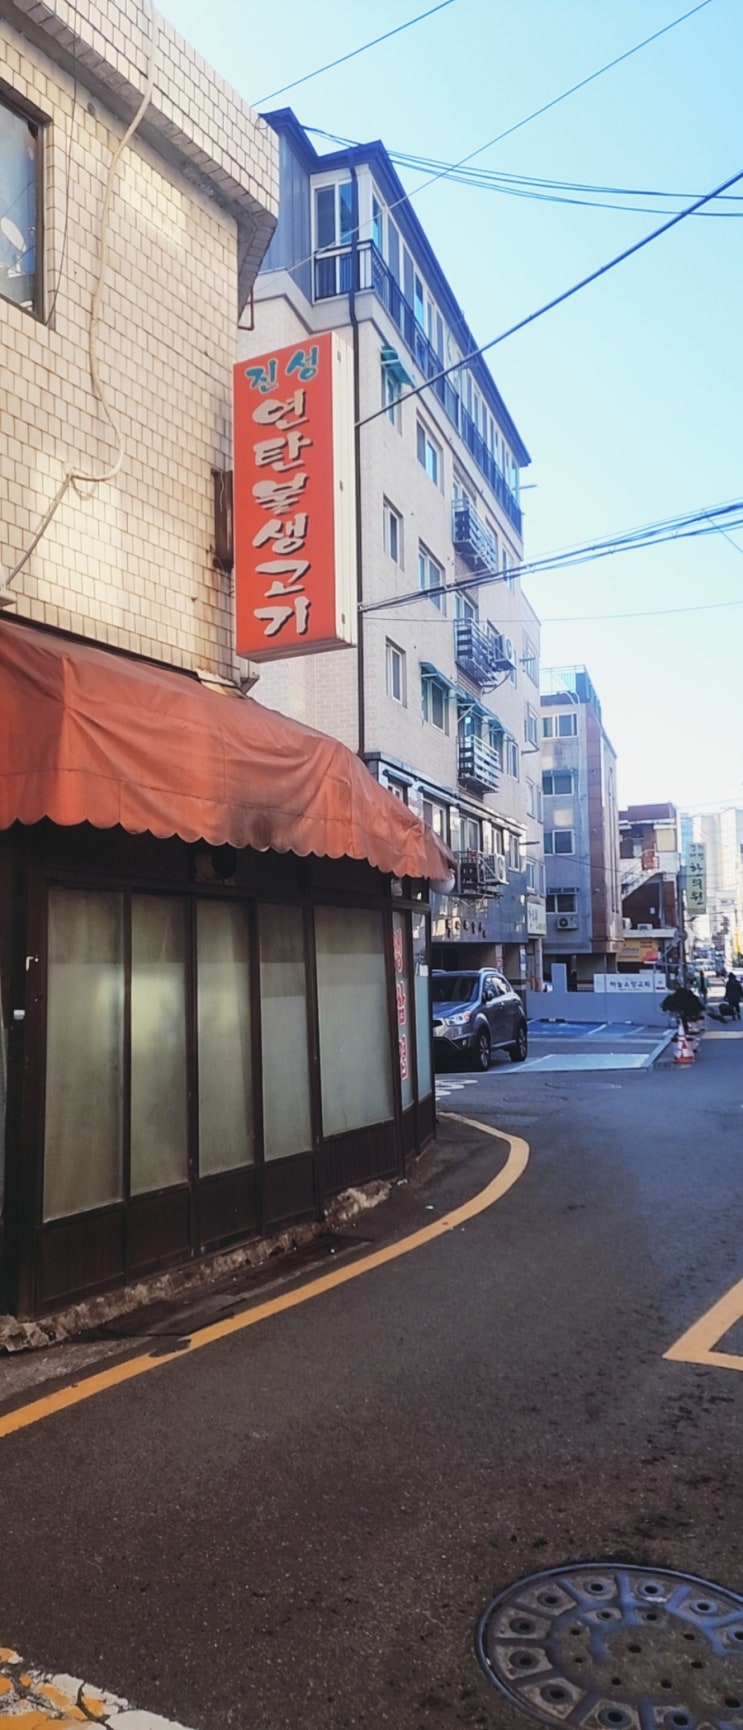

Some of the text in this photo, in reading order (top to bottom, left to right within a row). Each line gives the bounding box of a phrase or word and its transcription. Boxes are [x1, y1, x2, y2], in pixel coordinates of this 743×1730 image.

[244, 345, 319, 391] 진성
[251, 387, 314, 637] 연탄불생고기
[690, 862, 704, 905] 한의원
